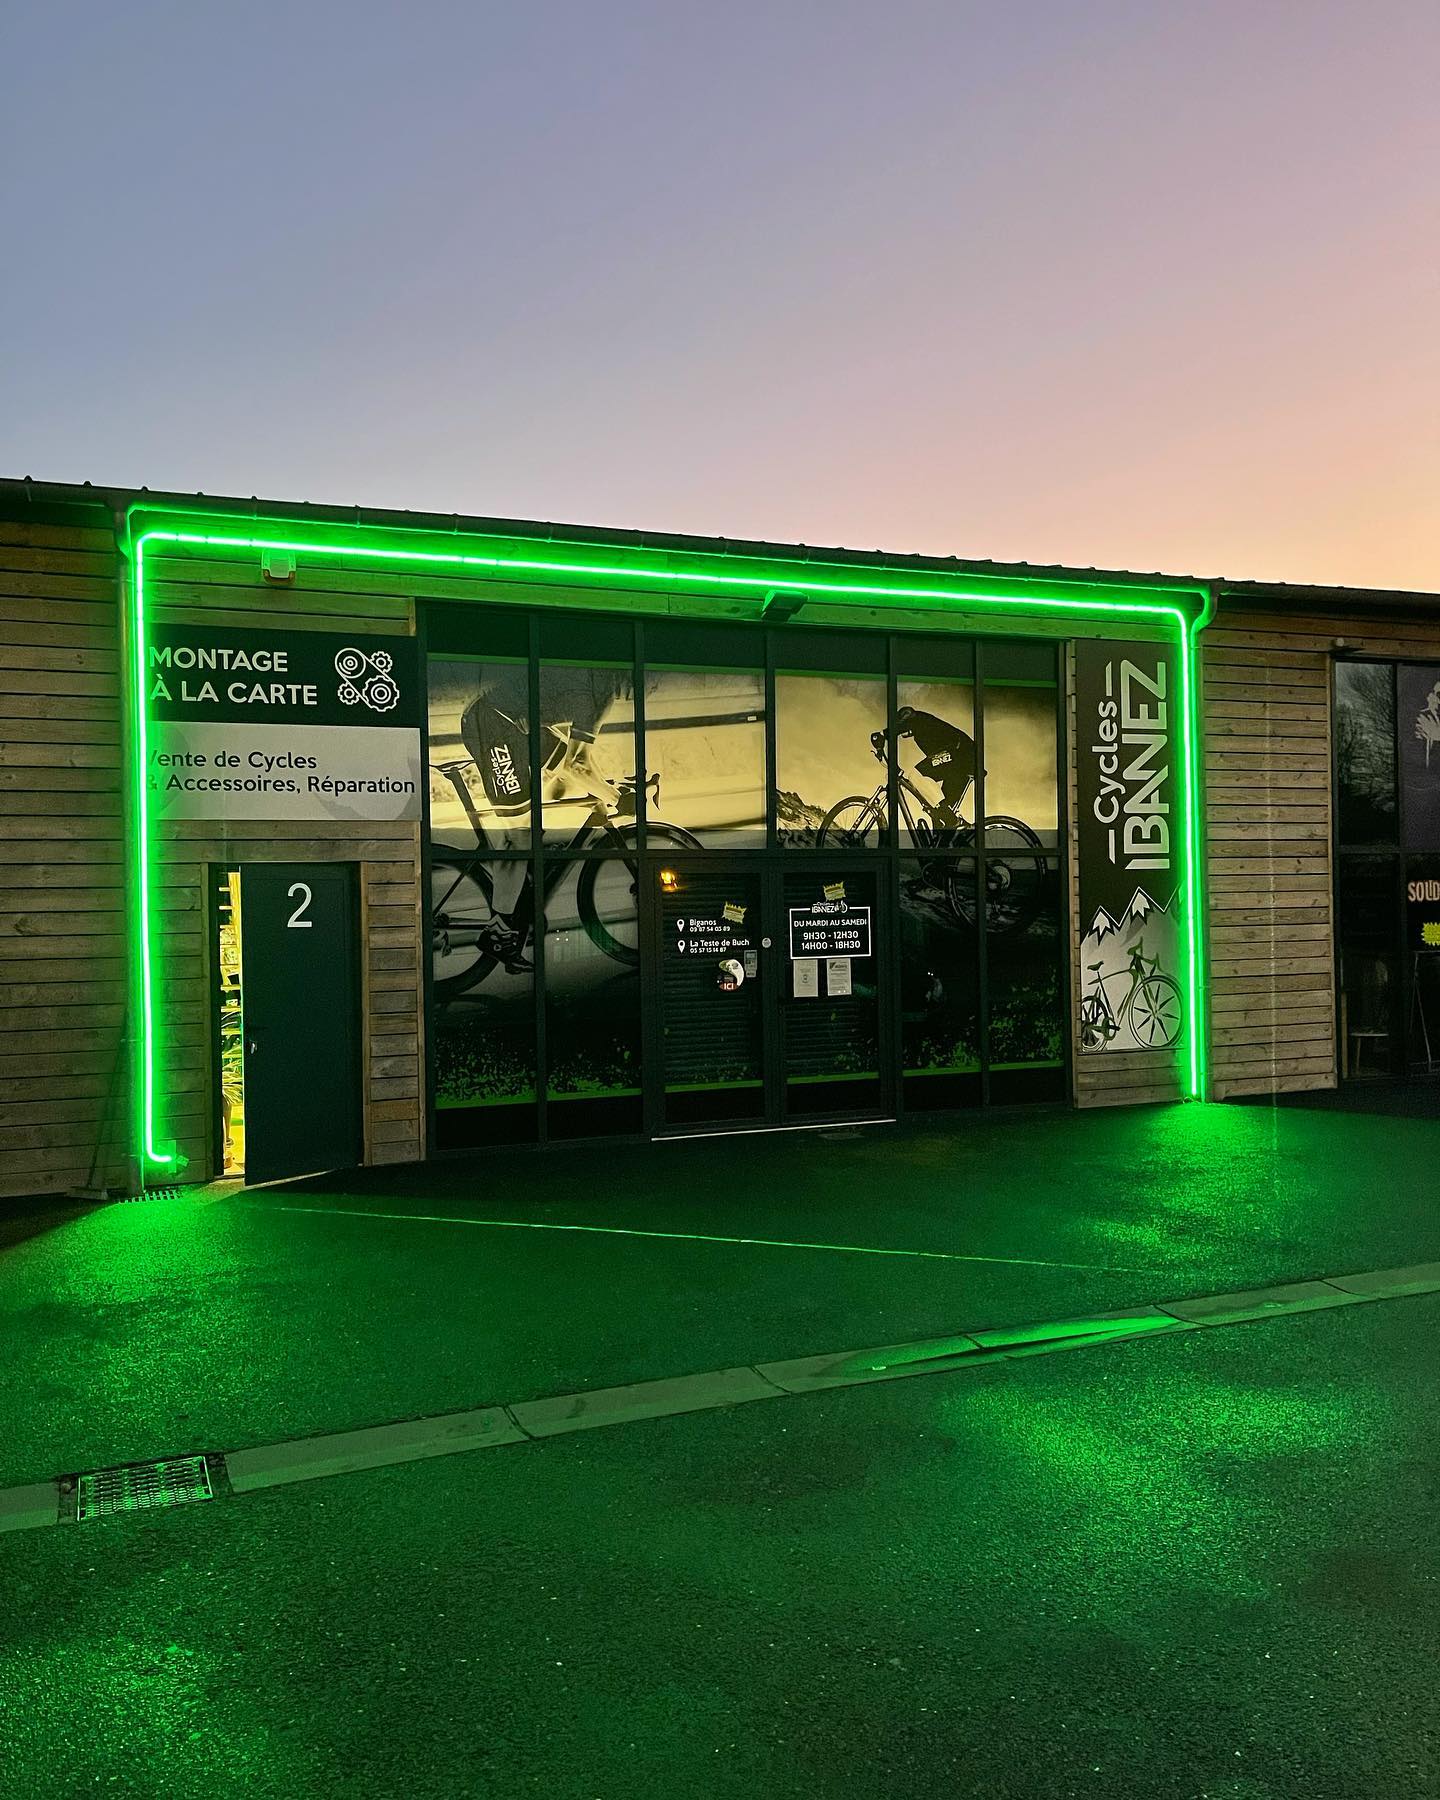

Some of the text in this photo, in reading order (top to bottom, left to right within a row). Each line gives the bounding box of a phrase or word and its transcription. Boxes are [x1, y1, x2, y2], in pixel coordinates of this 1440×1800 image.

[150, 647, 288, 672] MONTAGE
[150, 674, 318, 705] À LA CARTE
[214, 751, 240, 767] de
[248, 752, 317, 773] Cycles
[494, 744, 521, 794] IBANEZ
[1091, 701, 1126, 824] Cycles
[1120, 659, 1170, 870] IBANEZ
[165, 774, 301, 794] Accessoires,
[307, 775, 415, 797] Réparation
[287, 882, 312, 928] 2
[689, 919, 717, 928] Biganos
[841, 918, 867, 926] SAMEDI
[689, 938, 750, 947] La Teste de Buch
[801, 941, 828, 950] 14H00
[803, 931, 826, 940] 9H30
[833, 930, 859, 939] 12H30
